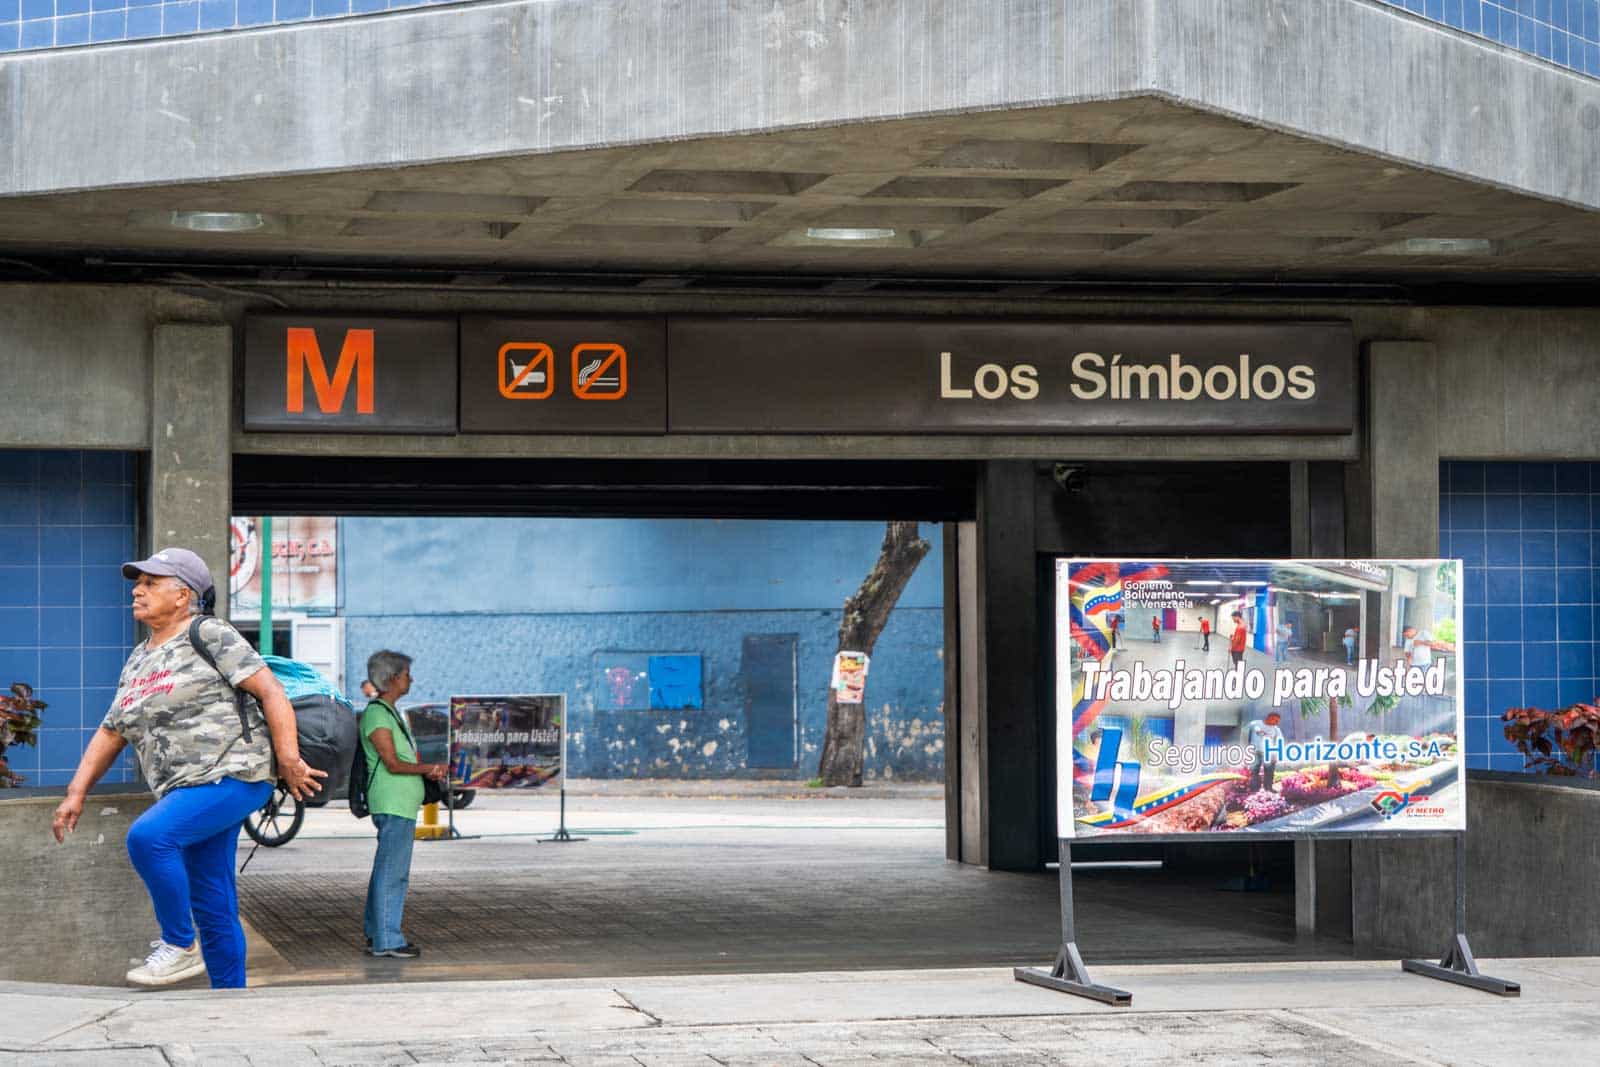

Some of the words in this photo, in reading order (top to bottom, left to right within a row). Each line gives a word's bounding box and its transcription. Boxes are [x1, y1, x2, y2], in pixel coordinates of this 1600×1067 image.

[287, 327, 374, 414] M
[940, 352, 1040, 400] Los
[1070, 352, 1316, 400] Símbolos
[1124, 580, 1173, 590] Gobierno
[1124, 590, 1185, 600] Bolivariano
[1140, 600, 1193, 609] Venezuela
[1081, 659, 1265, 709] Trabajando
[1273, 667, 1347, 707] para
[1357, 656, 1447, 697] Usted
[454, 729, 505, 746] Trabajando
[506, 731, 529, 745] para
[531, 729, 559, 743] Usted
[1149, 739, 1256, 773] Seguros
